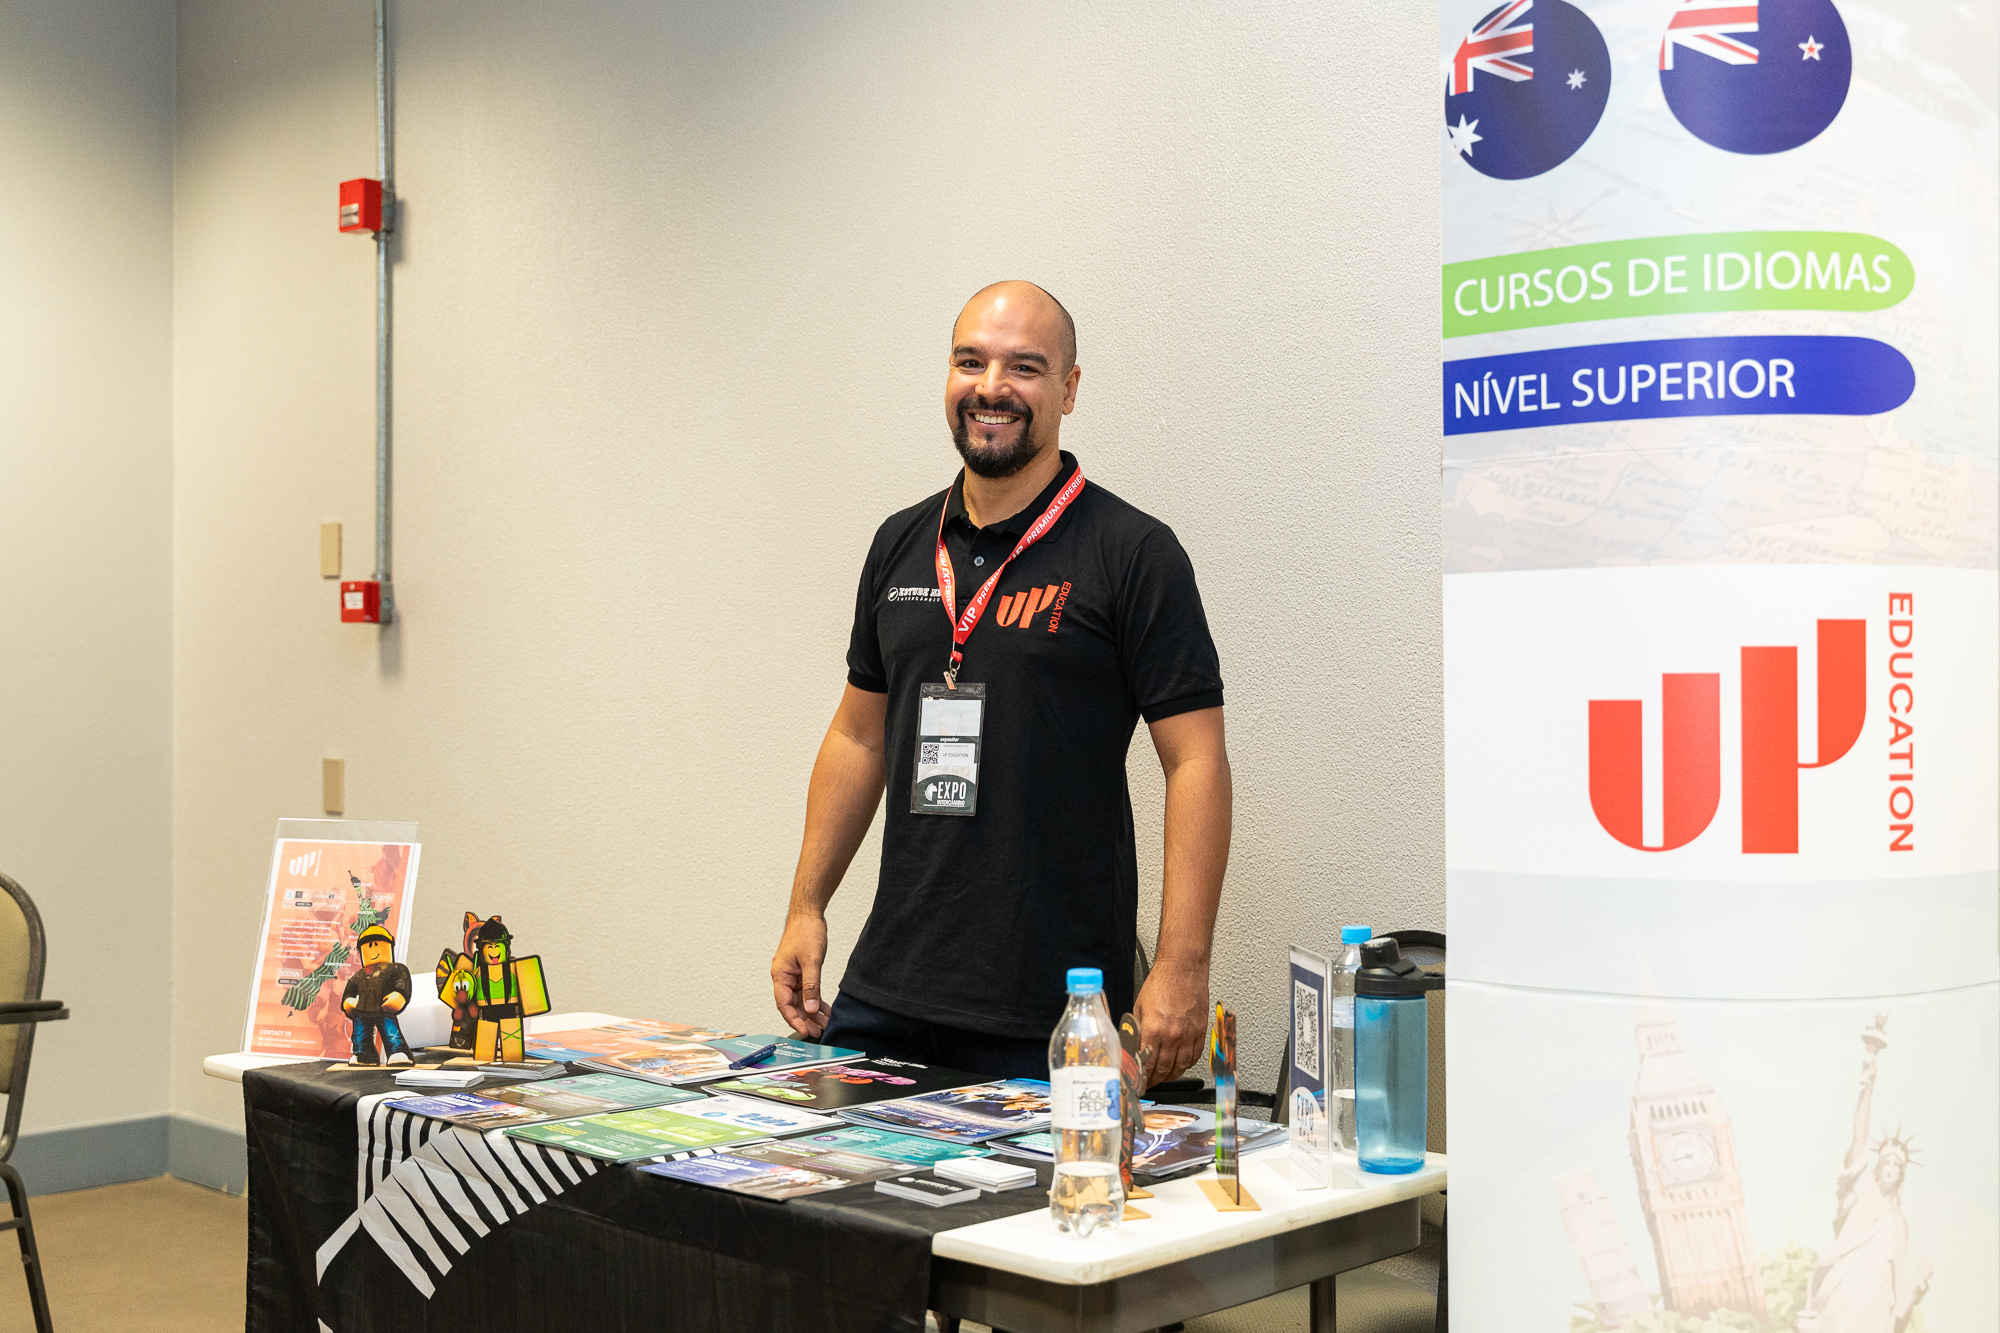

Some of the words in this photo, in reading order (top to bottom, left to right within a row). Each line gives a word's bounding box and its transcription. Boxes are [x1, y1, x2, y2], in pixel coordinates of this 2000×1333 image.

[1454, 262, 1614, 317] CURSOS
[1627, 256, 1688, 297] DE
[1703, 250, 1892, 294] IDIOMAS
[1454, 371, 1561, 419] NÍVEL
[1572, 358, 1796, 408] SUPERIOR
[1026, 505, 1061, 544] PREMIUM
[957, 606, 977, 633] VIP
[996, 584, 1060, 629] UP
[1047, 581, 1073, 634] EDUCATION
[1588, 618, 1867, 854] UP
[1888, 592, 1914, 852] EDUCATION
[937, 781, 967, 800] EXPO
[288, 851, 318, 877] UP
[259, 1028, 284, 1036] CONTACT
